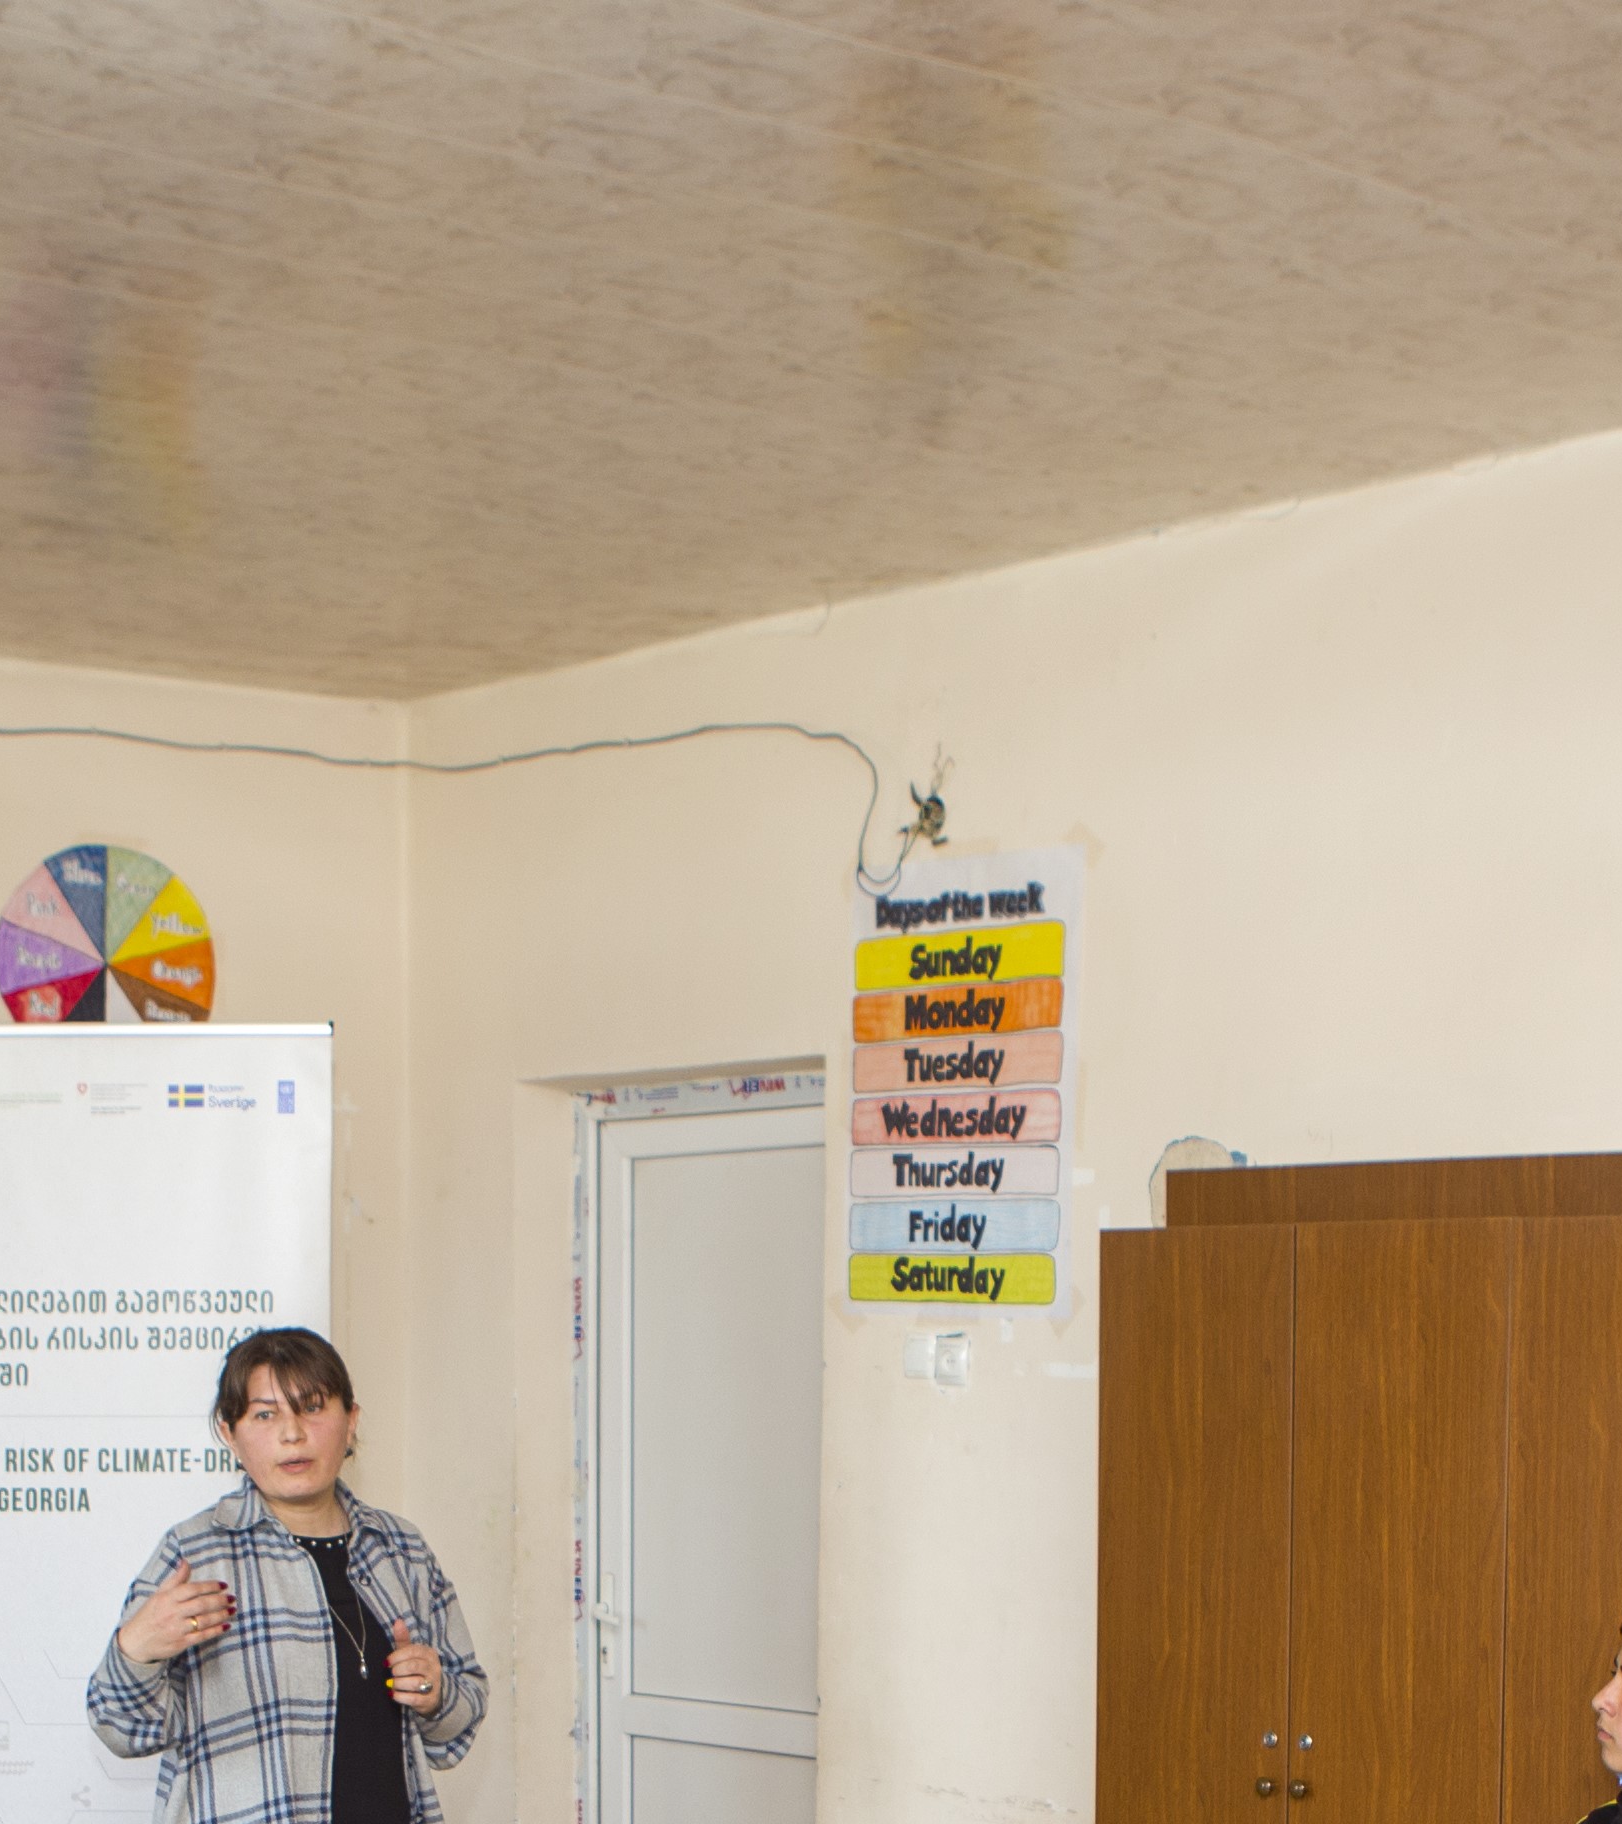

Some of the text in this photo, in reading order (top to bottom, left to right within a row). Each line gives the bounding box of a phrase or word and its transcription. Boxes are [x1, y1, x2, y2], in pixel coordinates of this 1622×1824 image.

[909, 936, 1002, 980] Sunday
[904, 988, 1005, 1032] Monday
[904, 1040, 1005, 1085] Tuesday
[881, 1096, 1027, 1140] Wednesday
[892, 1151, 1005, 1193] Thursday
[908, 1203, 987, 1250] Friday
[890, 1256, 1006, 1301] Saturday
[115, 1290, 274, 1314] გამოწვეული
[46, 1326, 139, 1350] რისკის
[5, 1448, 55, 1473] RISK
[64, 1448, 90, 1473] OF
